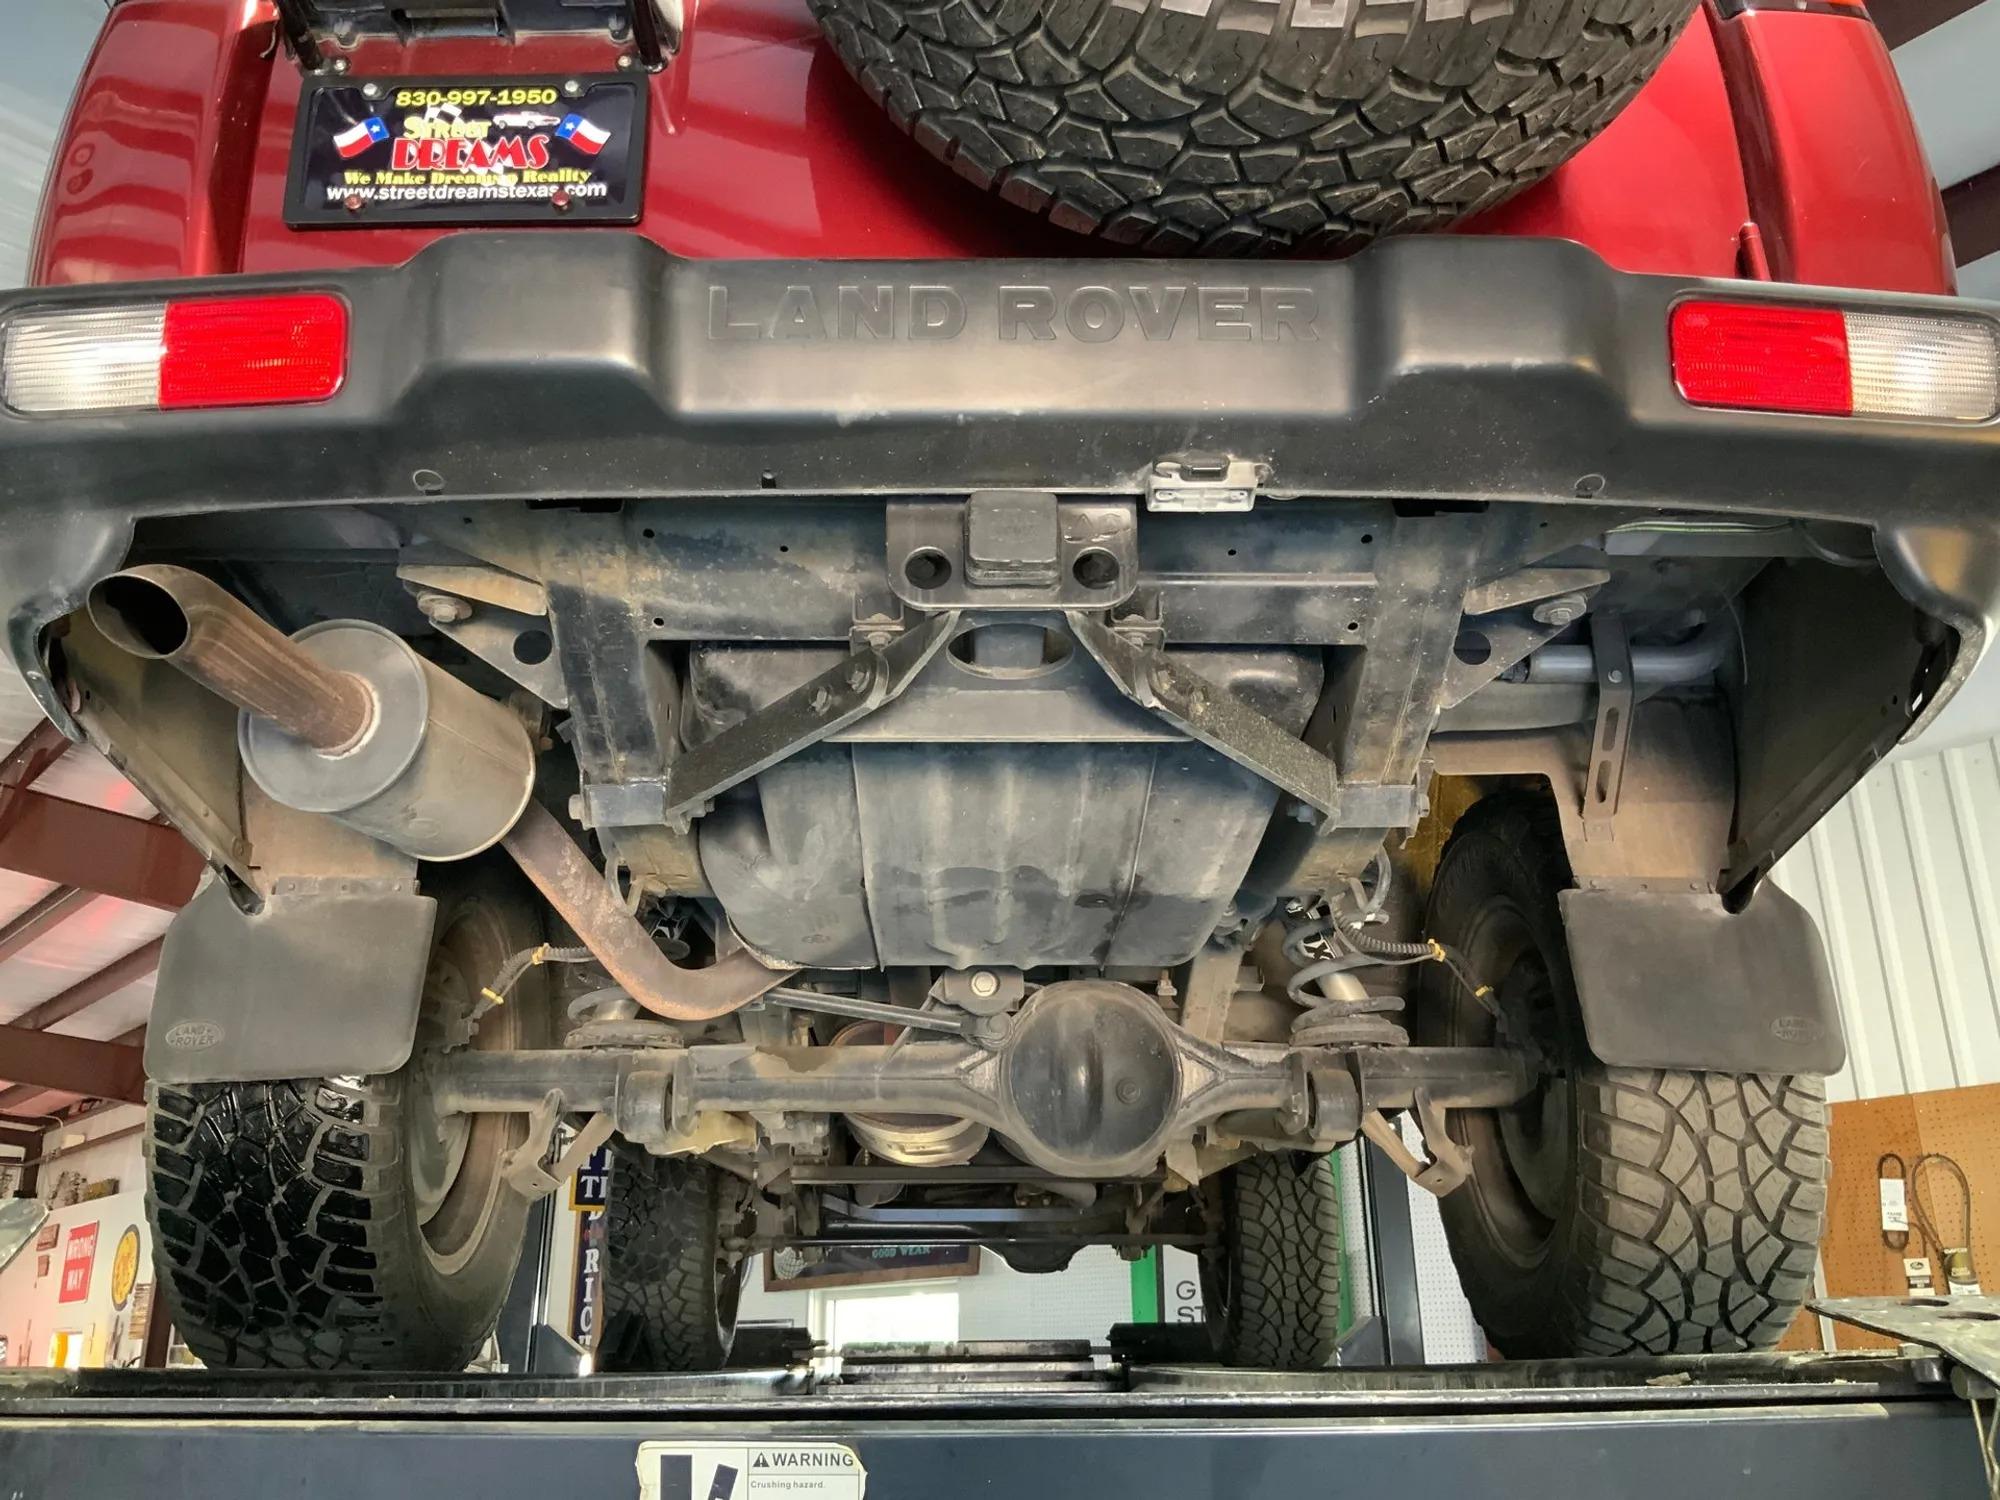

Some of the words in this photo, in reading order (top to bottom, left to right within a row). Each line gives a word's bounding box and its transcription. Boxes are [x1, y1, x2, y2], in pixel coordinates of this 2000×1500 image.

[395, 88, 558, 107] 830-997-1950
[391, 133, 551, 171] DREAMS
[343, 171, 372, 185] We
[375, 172, 426, 185] Make
[522, 168, 593, 185] Reality
[326, 182, 607, 200] www.streetdreamstexascom
[707, 285, 967, 341] LAND
[999, 285, 1320, 343] ROVER
[771, 1452, 855, 1467] WARNING
[750, 1480, 792, 1490] Crushing
[793, 1480, 827, 1489] hazard.
